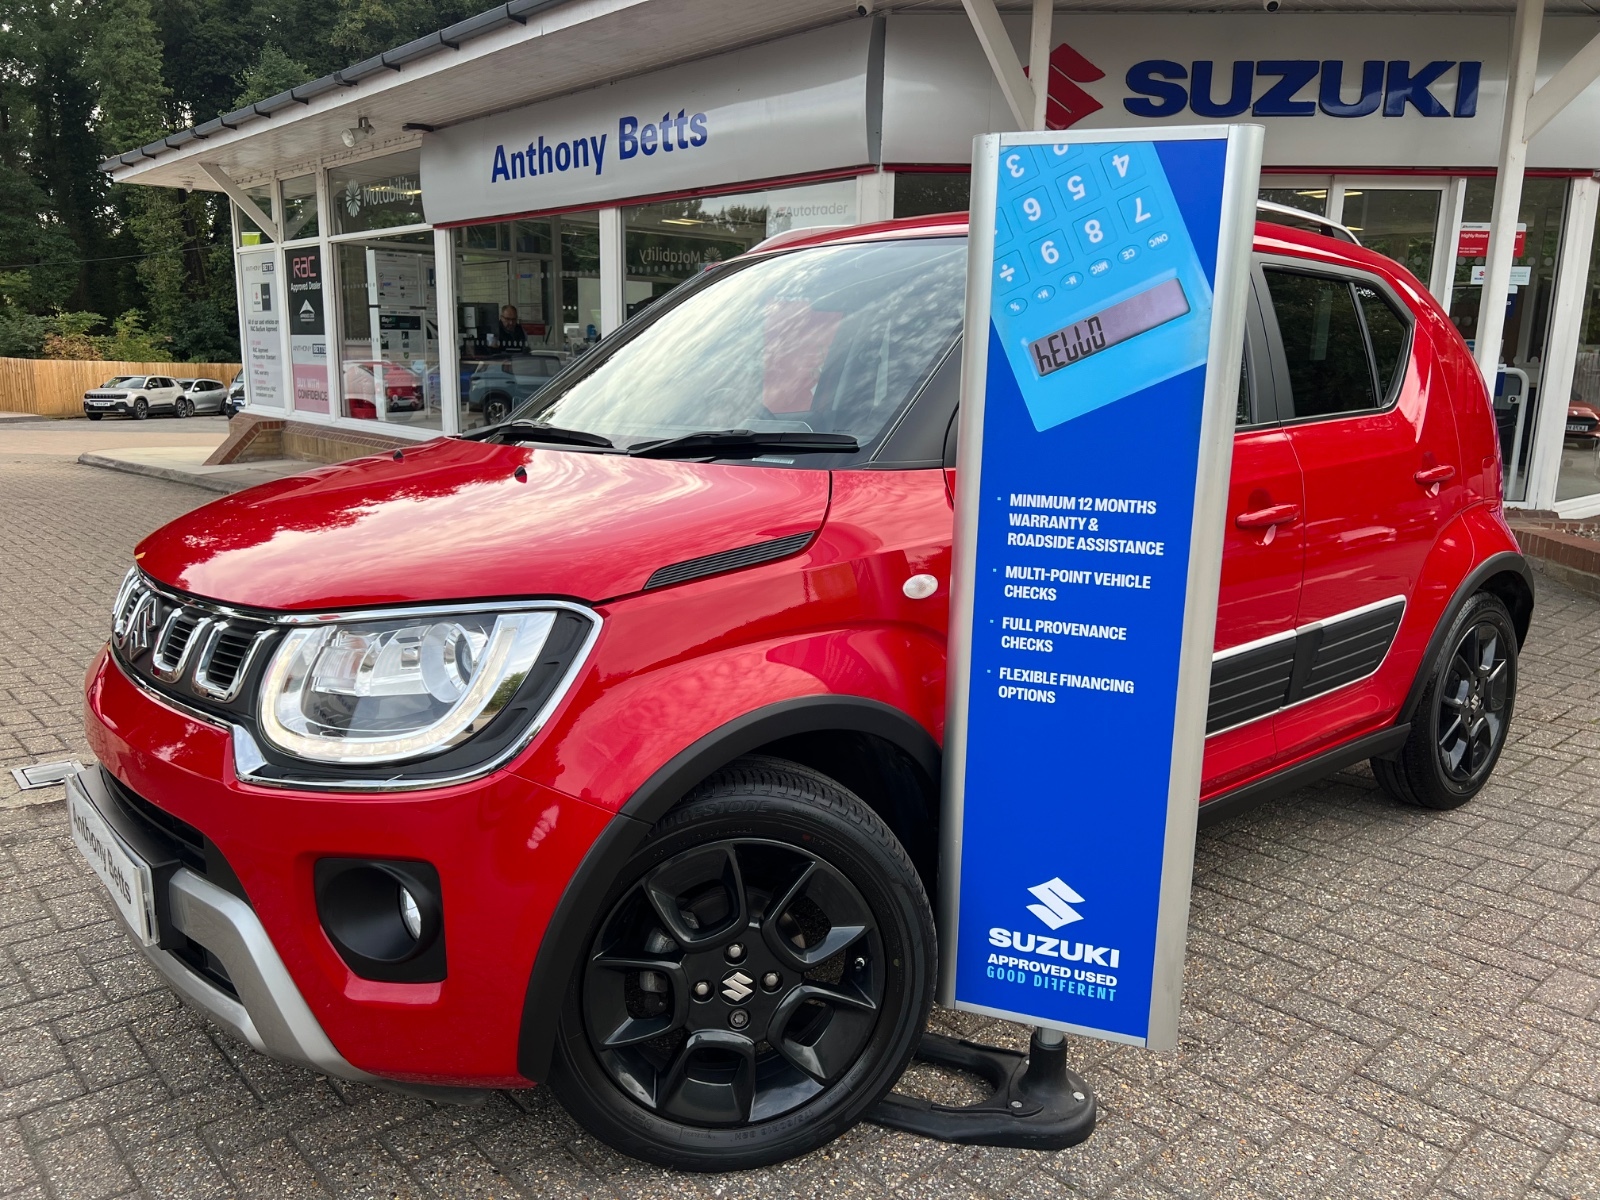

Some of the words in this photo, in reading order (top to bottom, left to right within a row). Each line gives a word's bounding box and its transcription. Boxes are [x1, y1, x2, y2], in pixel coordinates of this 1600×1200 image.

[1122, 60, 1482, 118] SUZUKI
[492, 134, 607, 183] Anthony
[619, 108, 708, 160] Betts
[364, 176, 416, 206] Motability
[786, 203, 848, 218] Autotrader
[1084, 220, 1103, 243] 8
[1148, 234, 1168, 248] ON/C
[1122, 248, 1136, 260] CE
[1090, 260, 1108, 275] MRC
[291, 282, 308, 293] Approved
[308, 281, 321, 290] Dealer
[297, 378, 307, 388] BUY
[308, 378, 320, 389] WITH
[298, 389, 328, 401] CONFIDENCE
[1010, 494, 1075, 510] MINIMUM
[1078, 498, 1092, 511] 12
[1095, 498, 1157, 514] MONTHS
[1009, 513, 1086, 531] WARRANTY
[1088, 518, 1099, 532] &
[1008, 532, 1075, 549] ROADSIDE
[1076, 537, 1164, 556] ASSISTANCE
[1006, 566, 1092, 585] MULTI-POINT
[1094, 572, 1151, 589] VEHICLE
[1004, 585, 1056, 601] CHECKS
[1002, 616, 1033, 632] FULL
[1035, 619, 1127, 640] PROVENANCE
[1002, 636, 1053, 652] CHECKS
[1000, 667, 1058, 685] FLEXIBLE
[1060, 674, 1134, 694] FINANCING
[998, 686, 1056, 704] OPTIONS
[72, 803, 106, 872] Anthony
[107, 848, 132, 904] Betts
[988, 928, 1120, 968] SUZUKI
[988, 954, 1071, 978] APPROVED
[1074, 969, 1117, 987] USED
[987, 966, 1026, 984] GOOD
[1034, 975, 1116, 1001] DIFFERENT
